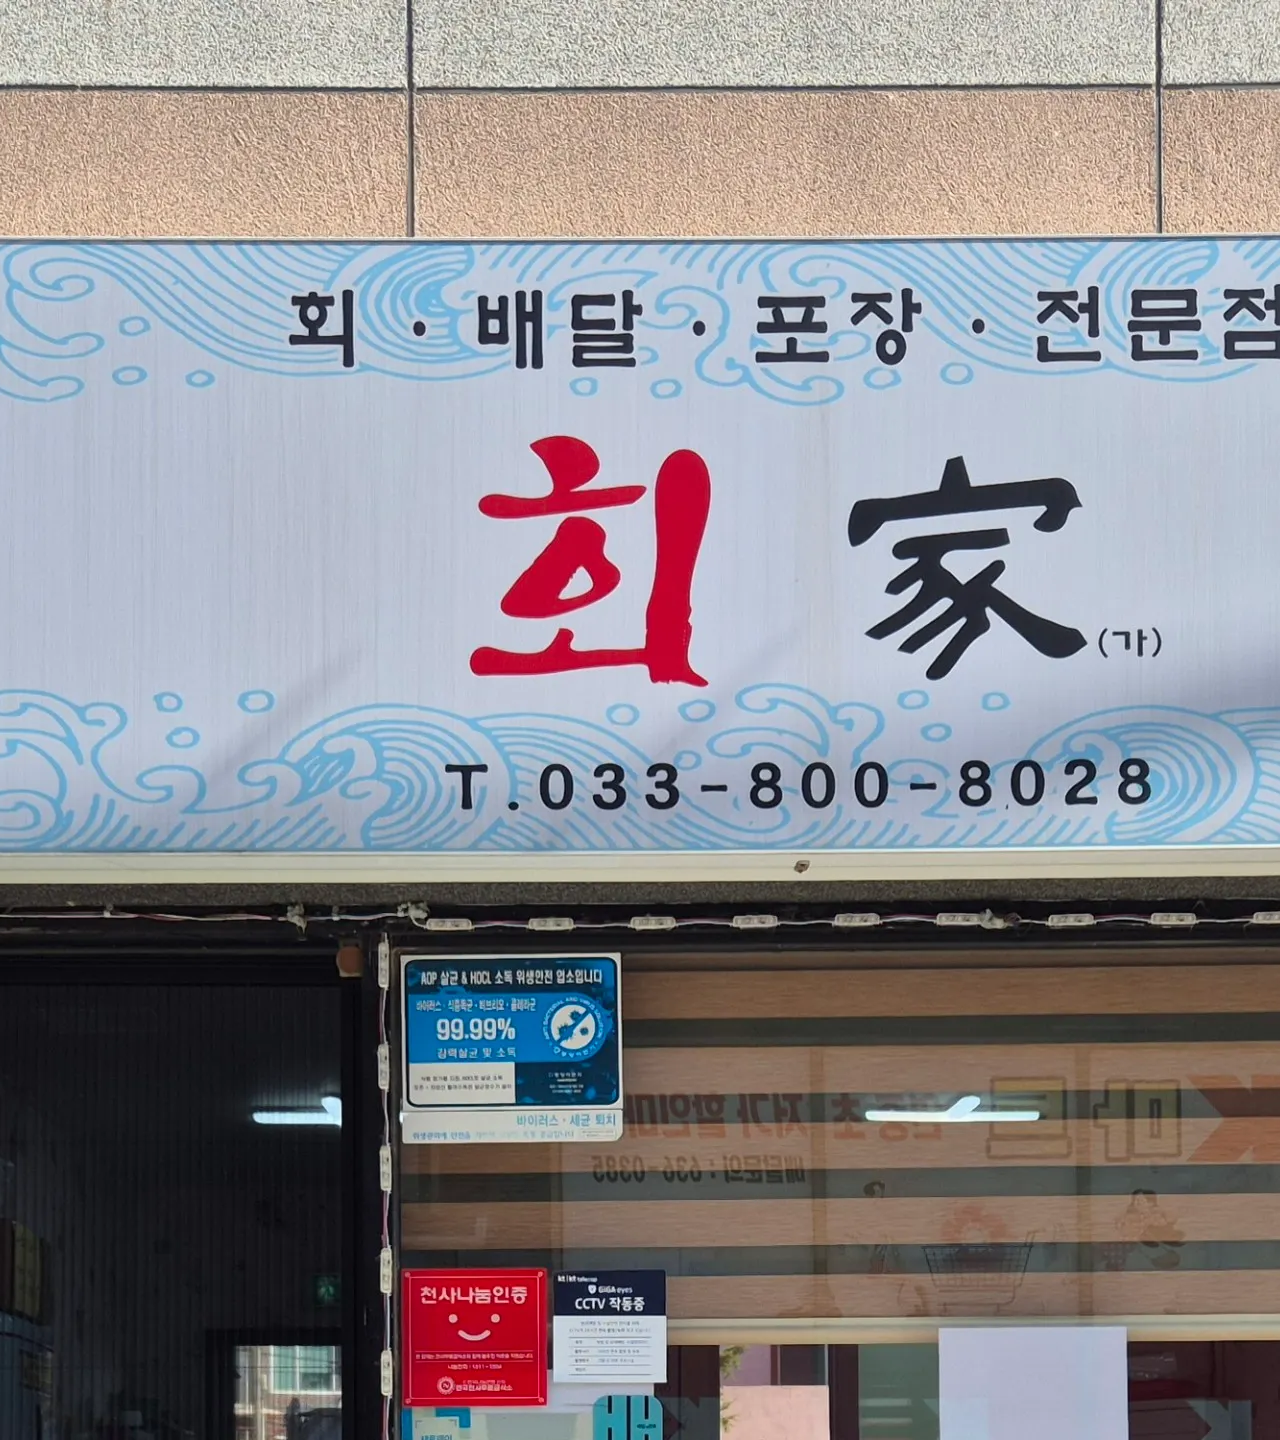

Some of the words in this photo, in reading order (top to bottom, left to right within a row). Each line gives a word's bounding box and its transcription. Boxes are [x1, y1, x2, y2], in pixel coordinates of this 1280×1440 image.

[289, 289, 355, 368] 회
[477, 289, 643, 369] 배달
[755, 288, 922, 366] 포장
[470, 435, 711, 687] 회
[847, 456, 1087, 680] 家
[445, 757, 1152, 811] T.033-800-8028
[421, 971, 437, 986] AOP
[440, 970, 460, 986] 살균
[470, 971, 492, 985] HOCL
[494, 970, 513, 985] 소독
[516, 969, 553, 985] 위생안전
[556, 969, 603, 984] 업소입니다
[436, 1017, 516, 1040] 99.99%
[517, 1115, 559, 1127] 바이러스
[570, 1114, 591, 1127] 세균
[595, 1113, 616, 1126] 퇴치
[420, 1285, 528, 1304] 천사나눔인증
[575, 1298, 606, 1310] CCTV
[609, 1296, 645, 1312] 작동중
